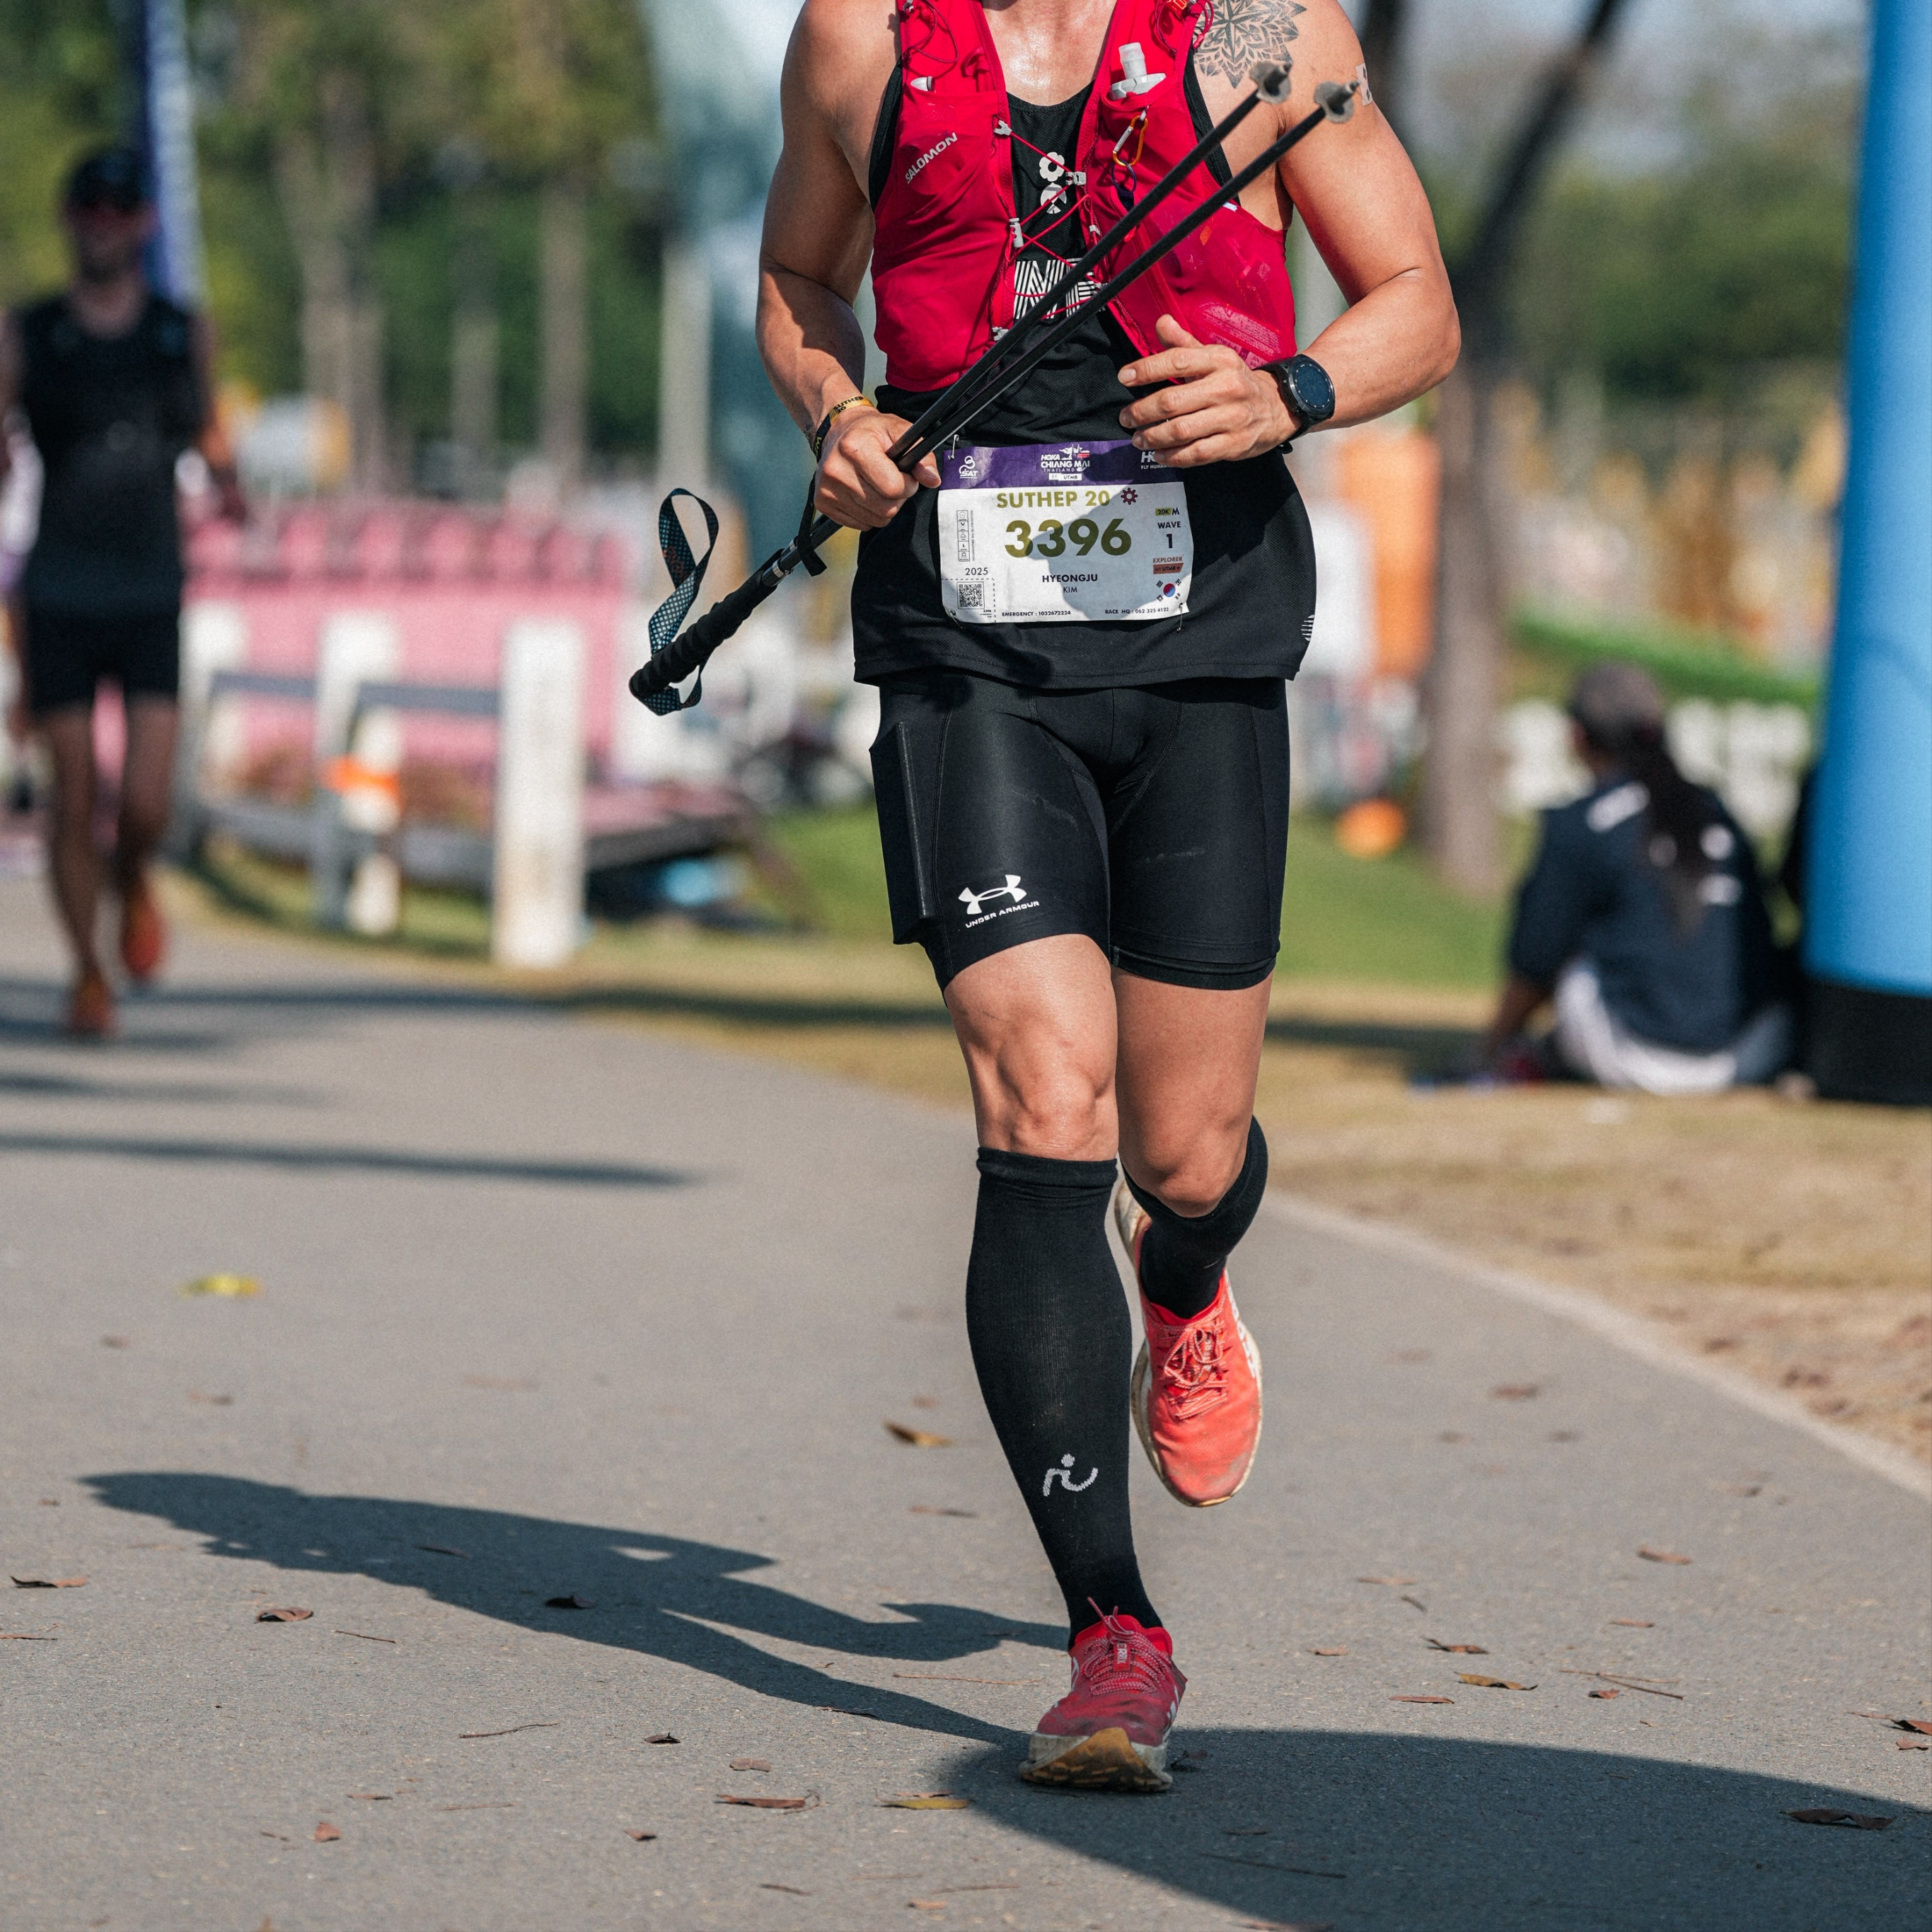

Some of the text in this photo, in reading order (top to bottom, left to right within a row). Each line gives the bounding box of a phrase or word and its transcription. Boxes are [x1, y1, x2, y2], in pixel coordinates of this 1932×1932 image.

[906, 132, 958, 184] SALOMON
[833, 396, 864, 410] SUTHEP
[835, 406, 846, 415] 20
[997, 490, 1111, 508] SUTHEP 20
[1005, 518, 1132, 558] 3396
[1166, 533, 1173, 548] 1
[1042, 574, 1098, 582] HYEONGJU
[965, 901, 1040, 928] UNDER ARMOUR
